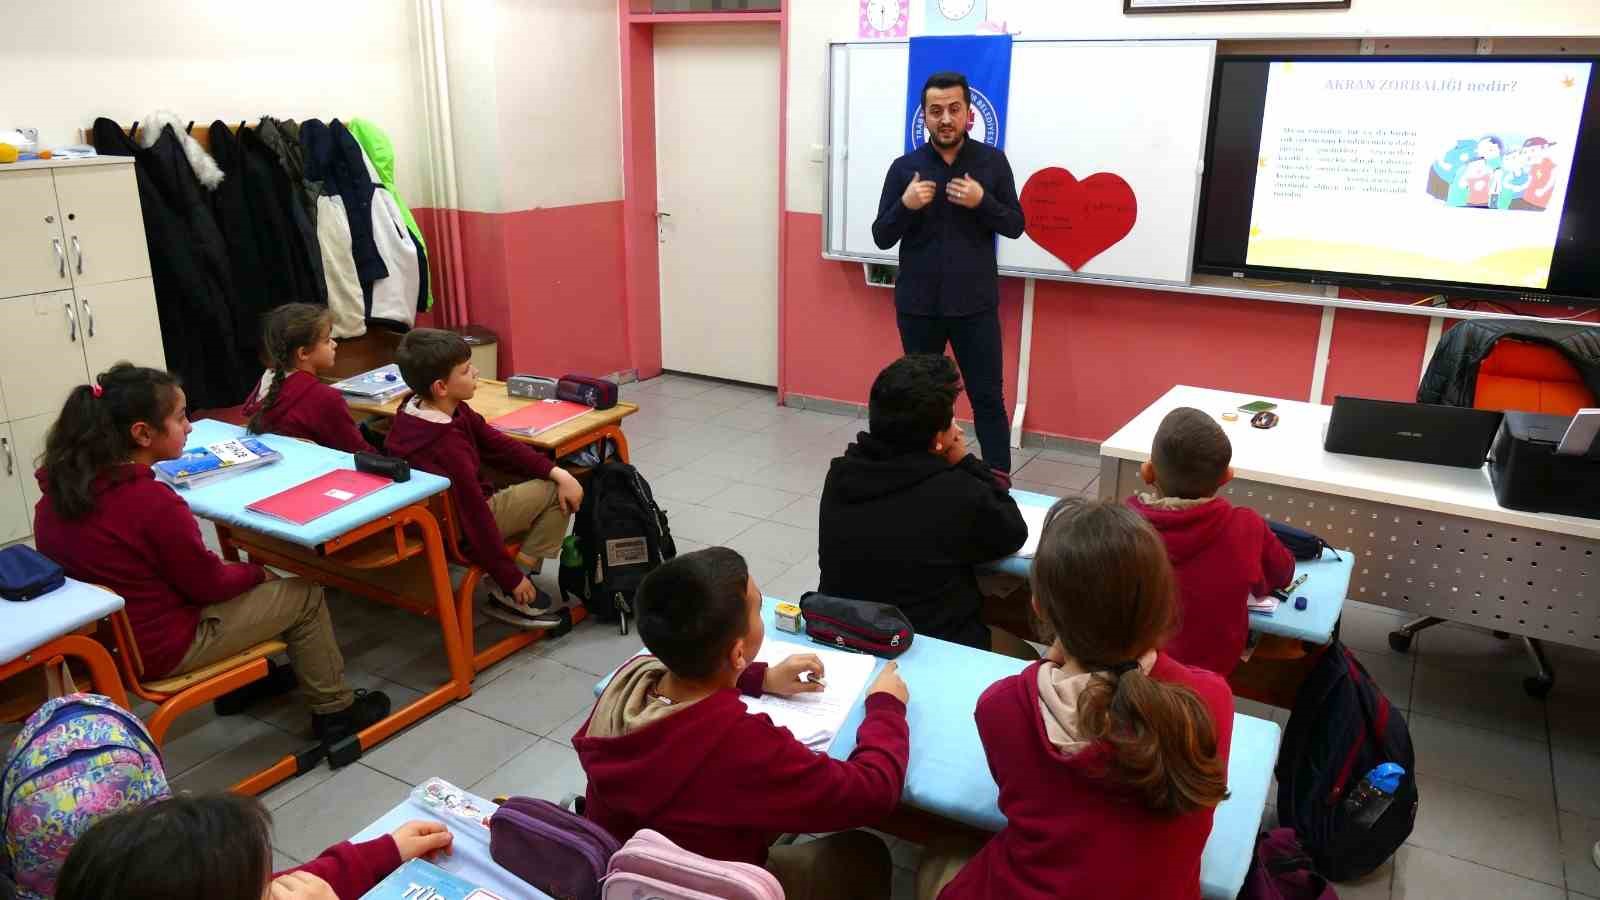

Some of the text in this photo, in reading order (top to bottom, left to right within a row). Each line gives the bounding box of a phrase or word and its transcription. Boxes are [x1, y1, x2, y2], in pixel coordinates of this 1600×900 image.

[1325, 72, 1519, 93] AKRAN ZORBALIĞI nedir?
